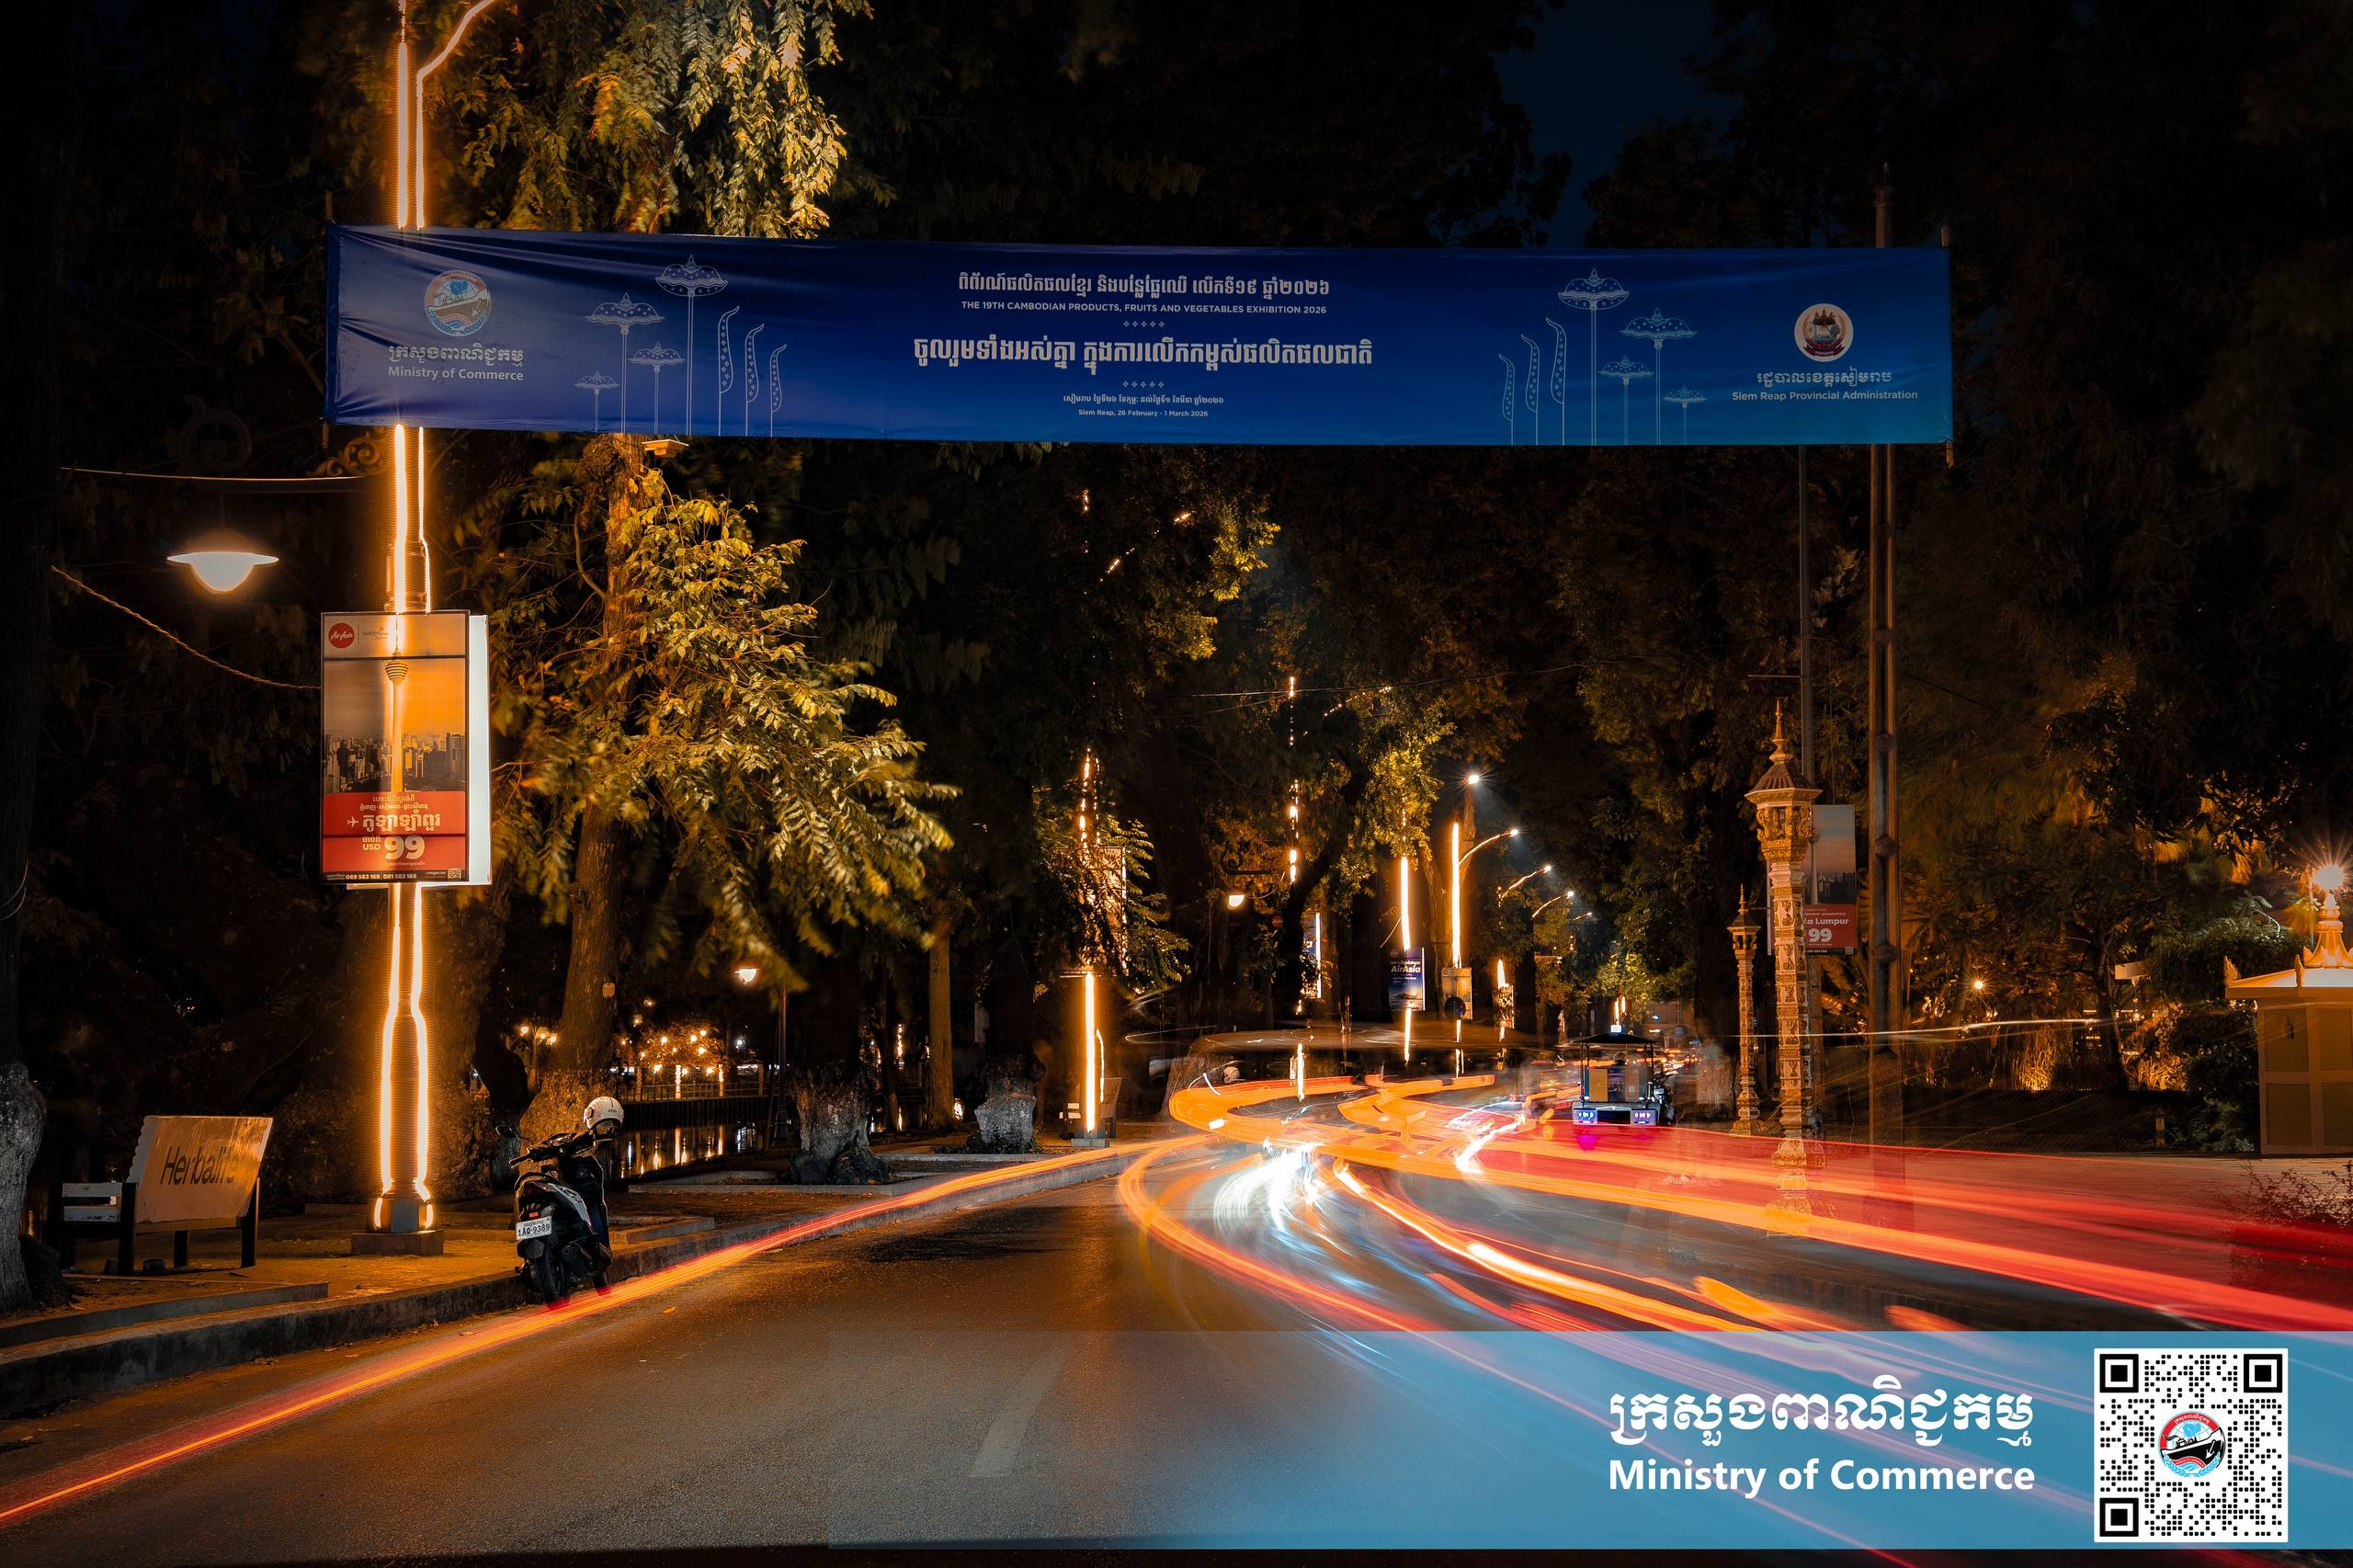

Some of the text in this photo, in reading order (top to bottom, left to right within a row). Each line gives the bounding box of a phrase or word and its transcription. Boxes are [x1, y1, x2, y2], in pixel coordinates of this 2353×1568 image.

[983, 301, 1004, 310] 19TH
[1007, 301, 1066, 311] CAMBODIAN
[1069, 303, 1121, 312] PRODUCTS,
[1125, 304, 1157, 312] FRUITS
[1184, 305, 1244, 313] VEGETABLES
[1246, 305, 1302, 313] EXHIBITION
[1303, 306, 1327, 314] 2026
[914, 334, 1075, 369] ចូលរួមទាំងអស់គ្នា
[389, 366, 524, 381] Ministry of Commerce
[1732, 391, 1918, 403] Siem Reap Provincial Administration
[1097, 409, 1116, 417] Reap,
[384, 835, 425, 860] 99
[1815, 917, 1849, 926] Lumpur
[1808, 928, 1833, 943] 99
[1391, 965, 1421, 973] AirAsia
